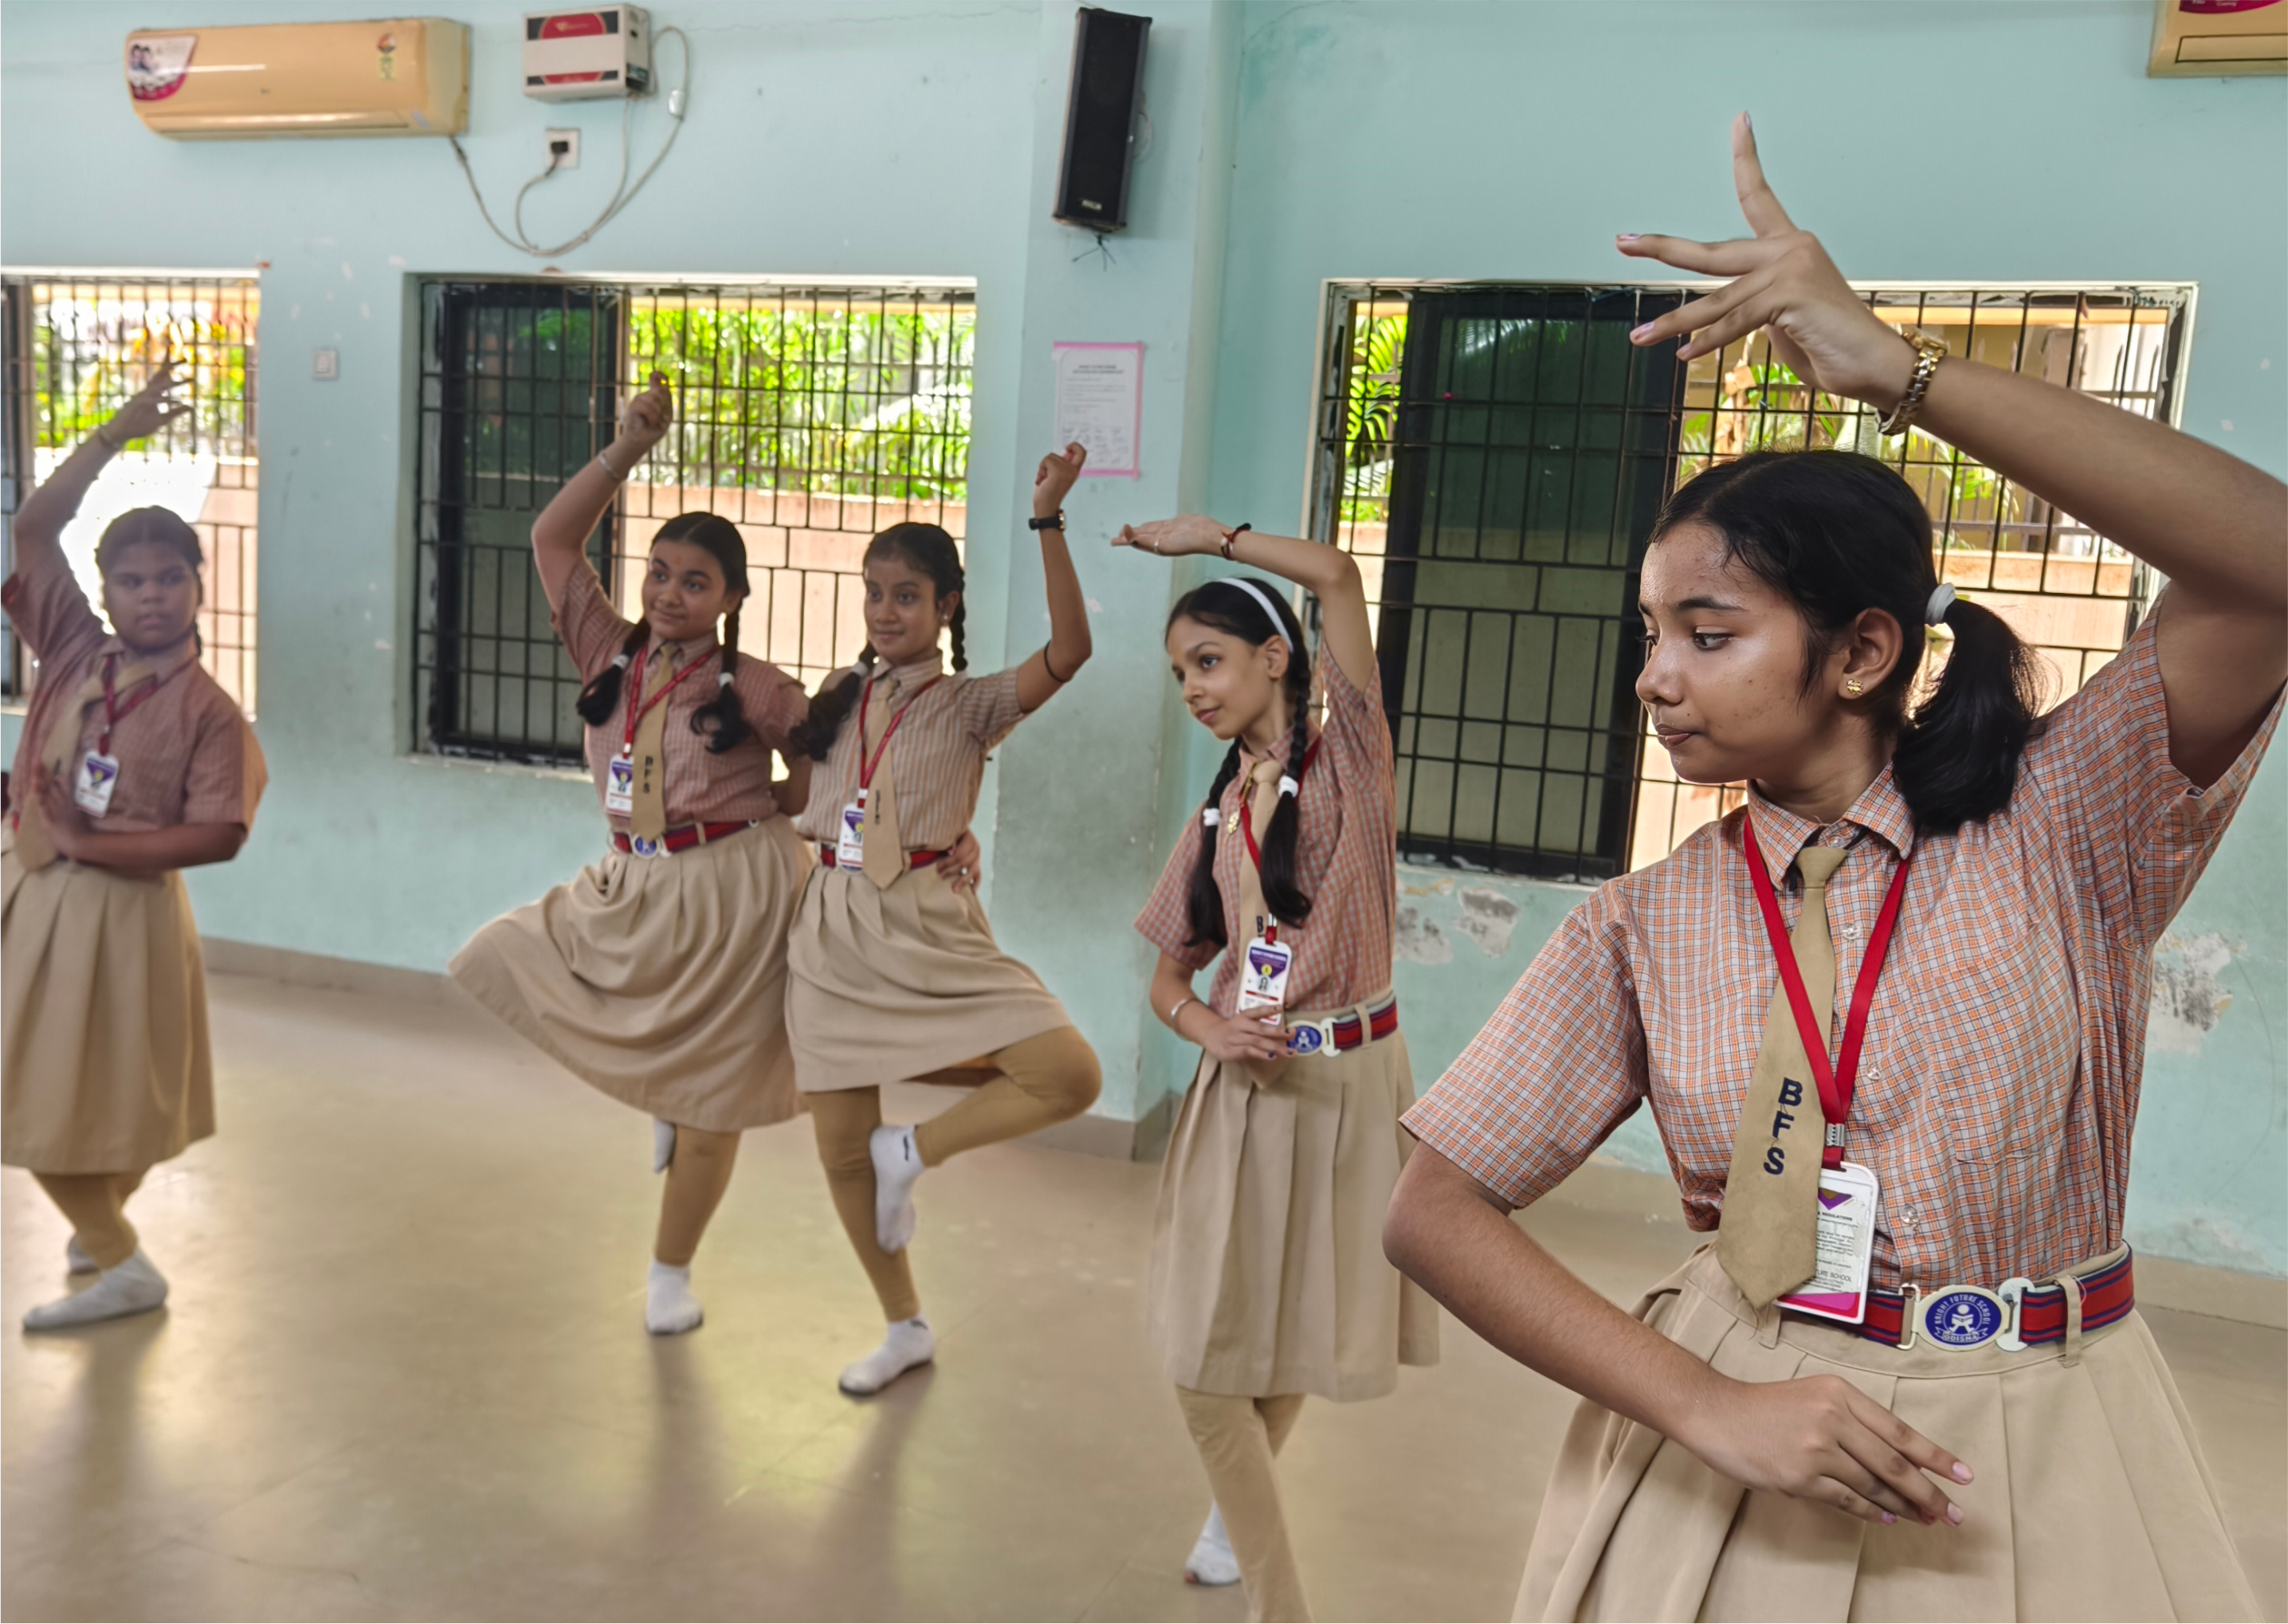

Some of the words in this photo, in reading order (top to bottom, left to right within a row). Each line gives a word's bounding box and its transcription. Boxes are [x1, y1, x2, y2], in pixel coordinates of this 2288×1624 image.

[1763, 1077, 1803, 1175] BFS
[1830, 1272, 1852, 1282] SCHOOL
[1934, 1301, 1949, 1324] BRIGHT
[1949, 1294, 1978, 1304] FUTURE
[1976, 1300, 1991, 1324] SCHOOL
